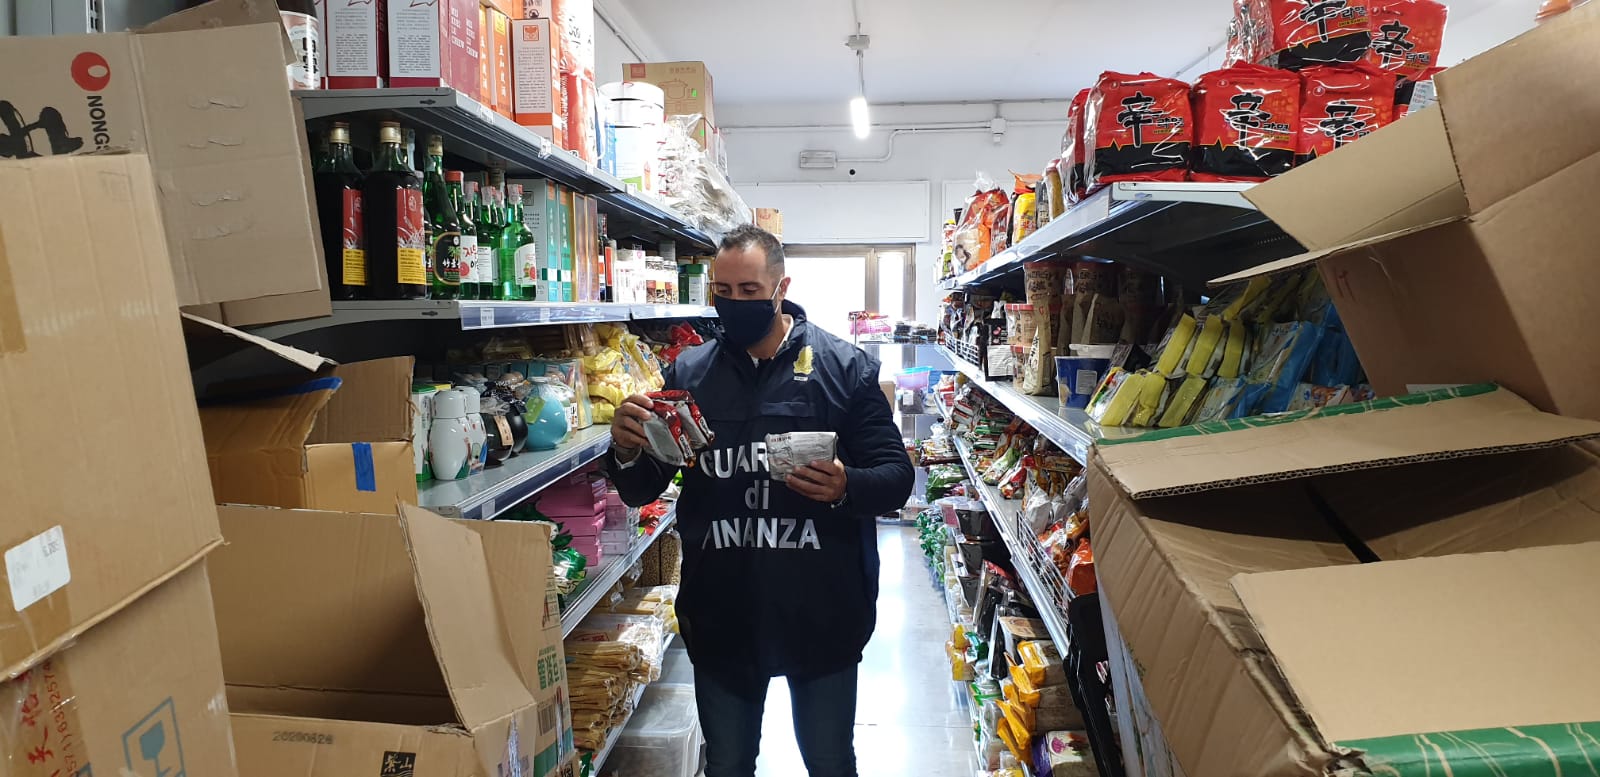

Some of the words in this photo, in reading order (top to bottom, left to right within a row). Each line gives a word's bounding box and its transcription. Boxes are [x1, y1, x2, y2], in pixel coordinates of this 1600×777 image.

[1117, 91, 1164, 148] 辛
[1224, 91, 1272, 149] 辛
[700, 442, 770, 478] GUAR
[745, 480, 770, 509] di
